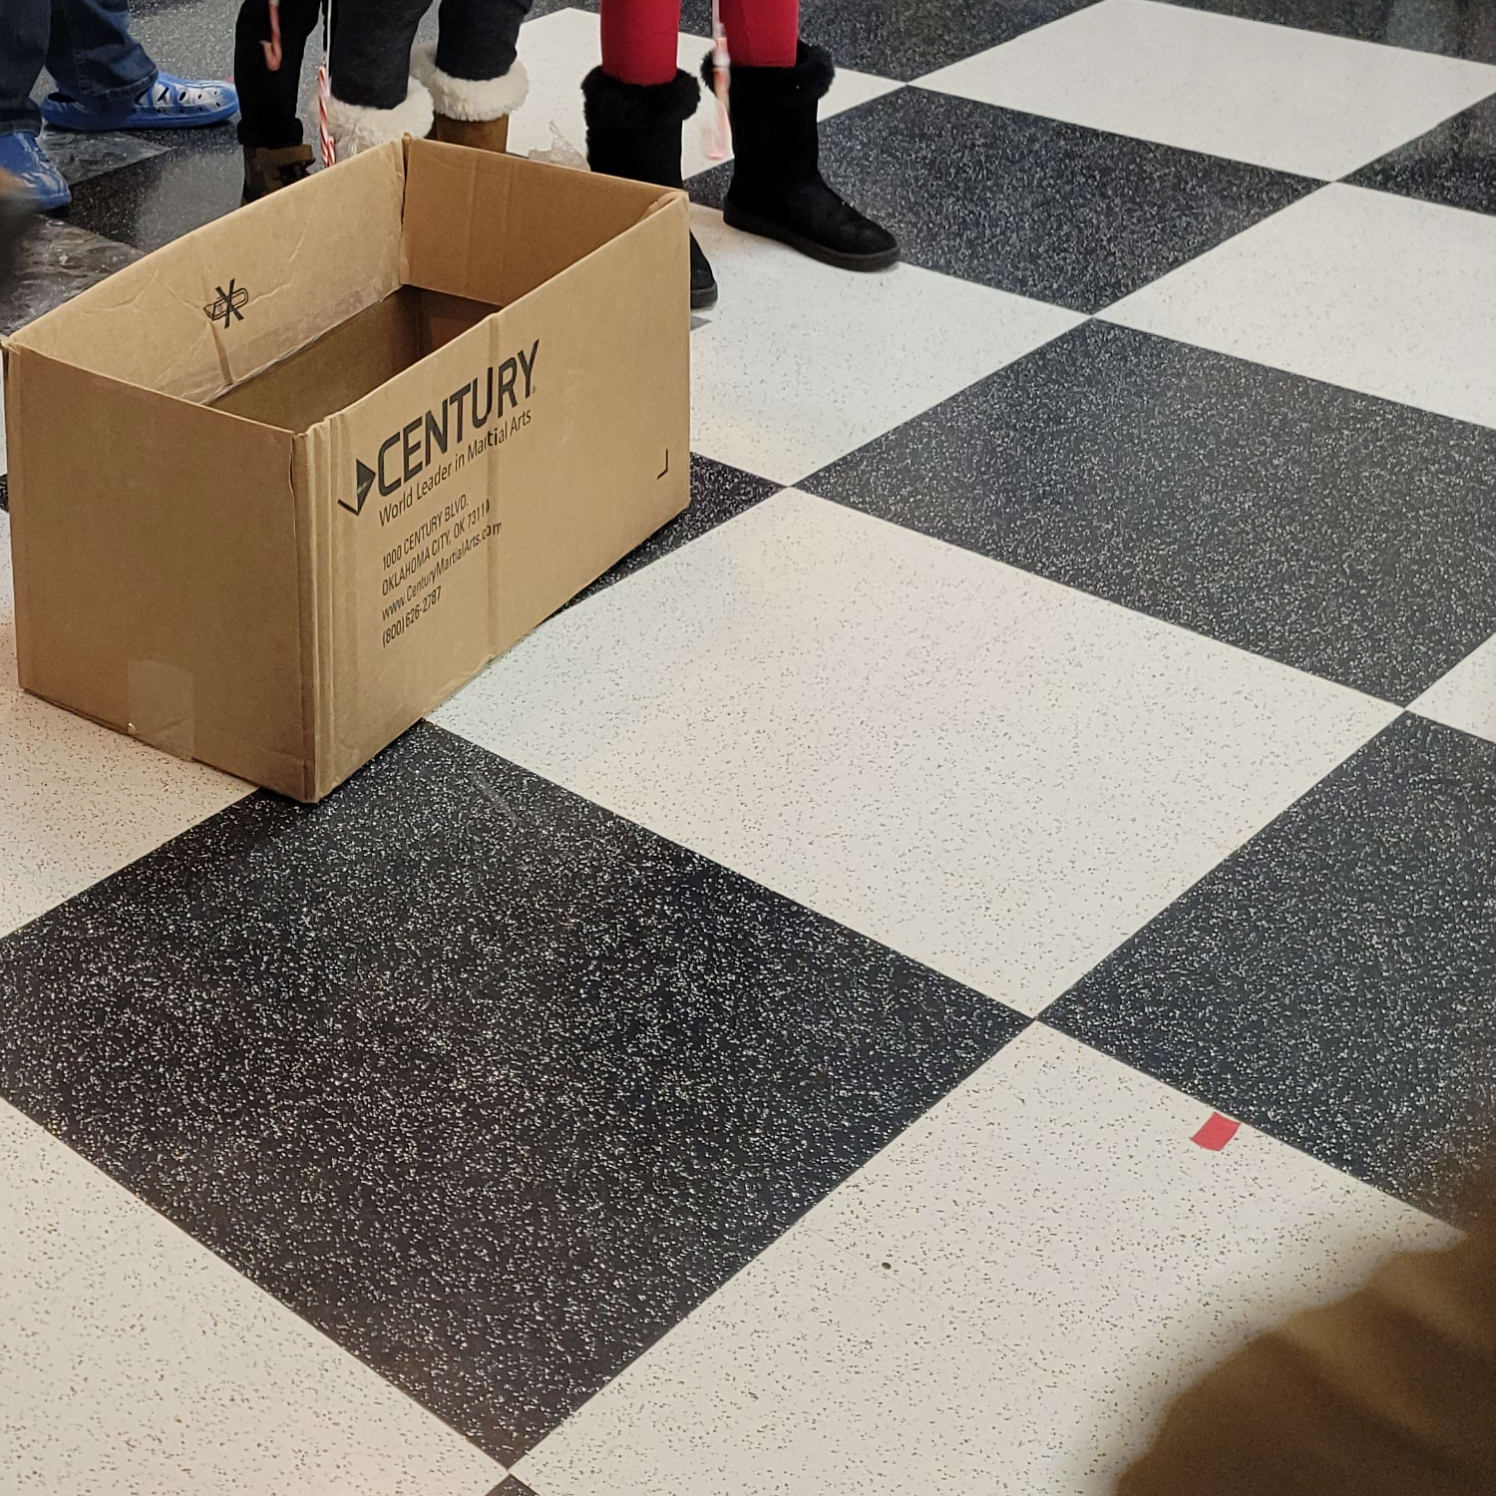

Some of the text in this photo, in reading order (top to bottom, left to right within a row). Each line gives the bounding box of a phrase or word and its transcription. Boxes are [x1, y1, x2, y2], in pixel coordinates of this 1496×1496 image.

[378, 339, 539, 497] CENTURY
[379, 410, 532, 528] World Leader in Martial Arts
[382, 547, 430, 596] OKLAHOMA
[454, 517, 468, 538] OK
[383, 494, 469, 571] 1000 CENTURY BLVD.
[382, 585, 442, 648] (800) 626-2787
